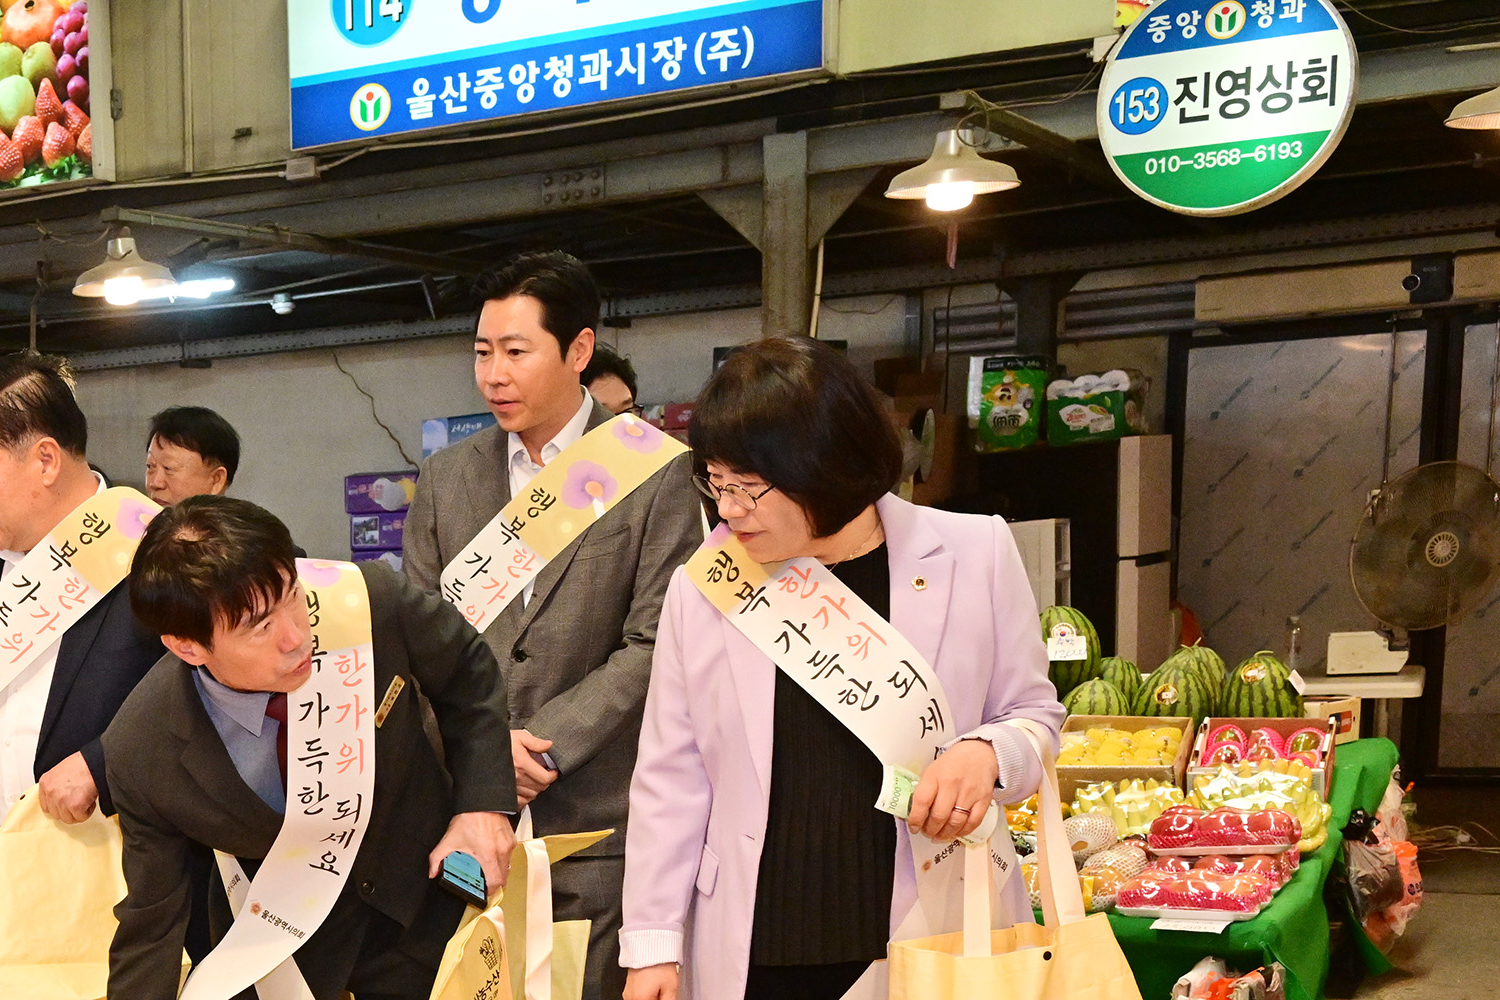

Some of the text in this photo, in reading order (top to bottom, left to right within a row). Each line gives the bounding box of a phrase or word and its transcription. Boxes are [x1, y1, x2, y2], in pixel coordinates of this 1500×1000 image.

[1147, 0, 1308, 44] 중앙 청과
[406, 25, 755, 121] 울산중앙청과시장(주)
[1114, 54, 1338, 125] 153 진영상회
[1144, 140, 1303, 175] 010-3568-6193
[50, 512, 111, 572] 행복
[499, 487, 557, 546] 행복
[0, 576, 89, 664] 한가위
[706, 551, 879, 711] 행복 가득한
[778, 566, 946, 760] 한가위 되세
[297, 692, 330, 816] 가득한
[309, 649, 368, 877] 한가위 되세요
[261, 909, 306, 940] 울산광역시의회
